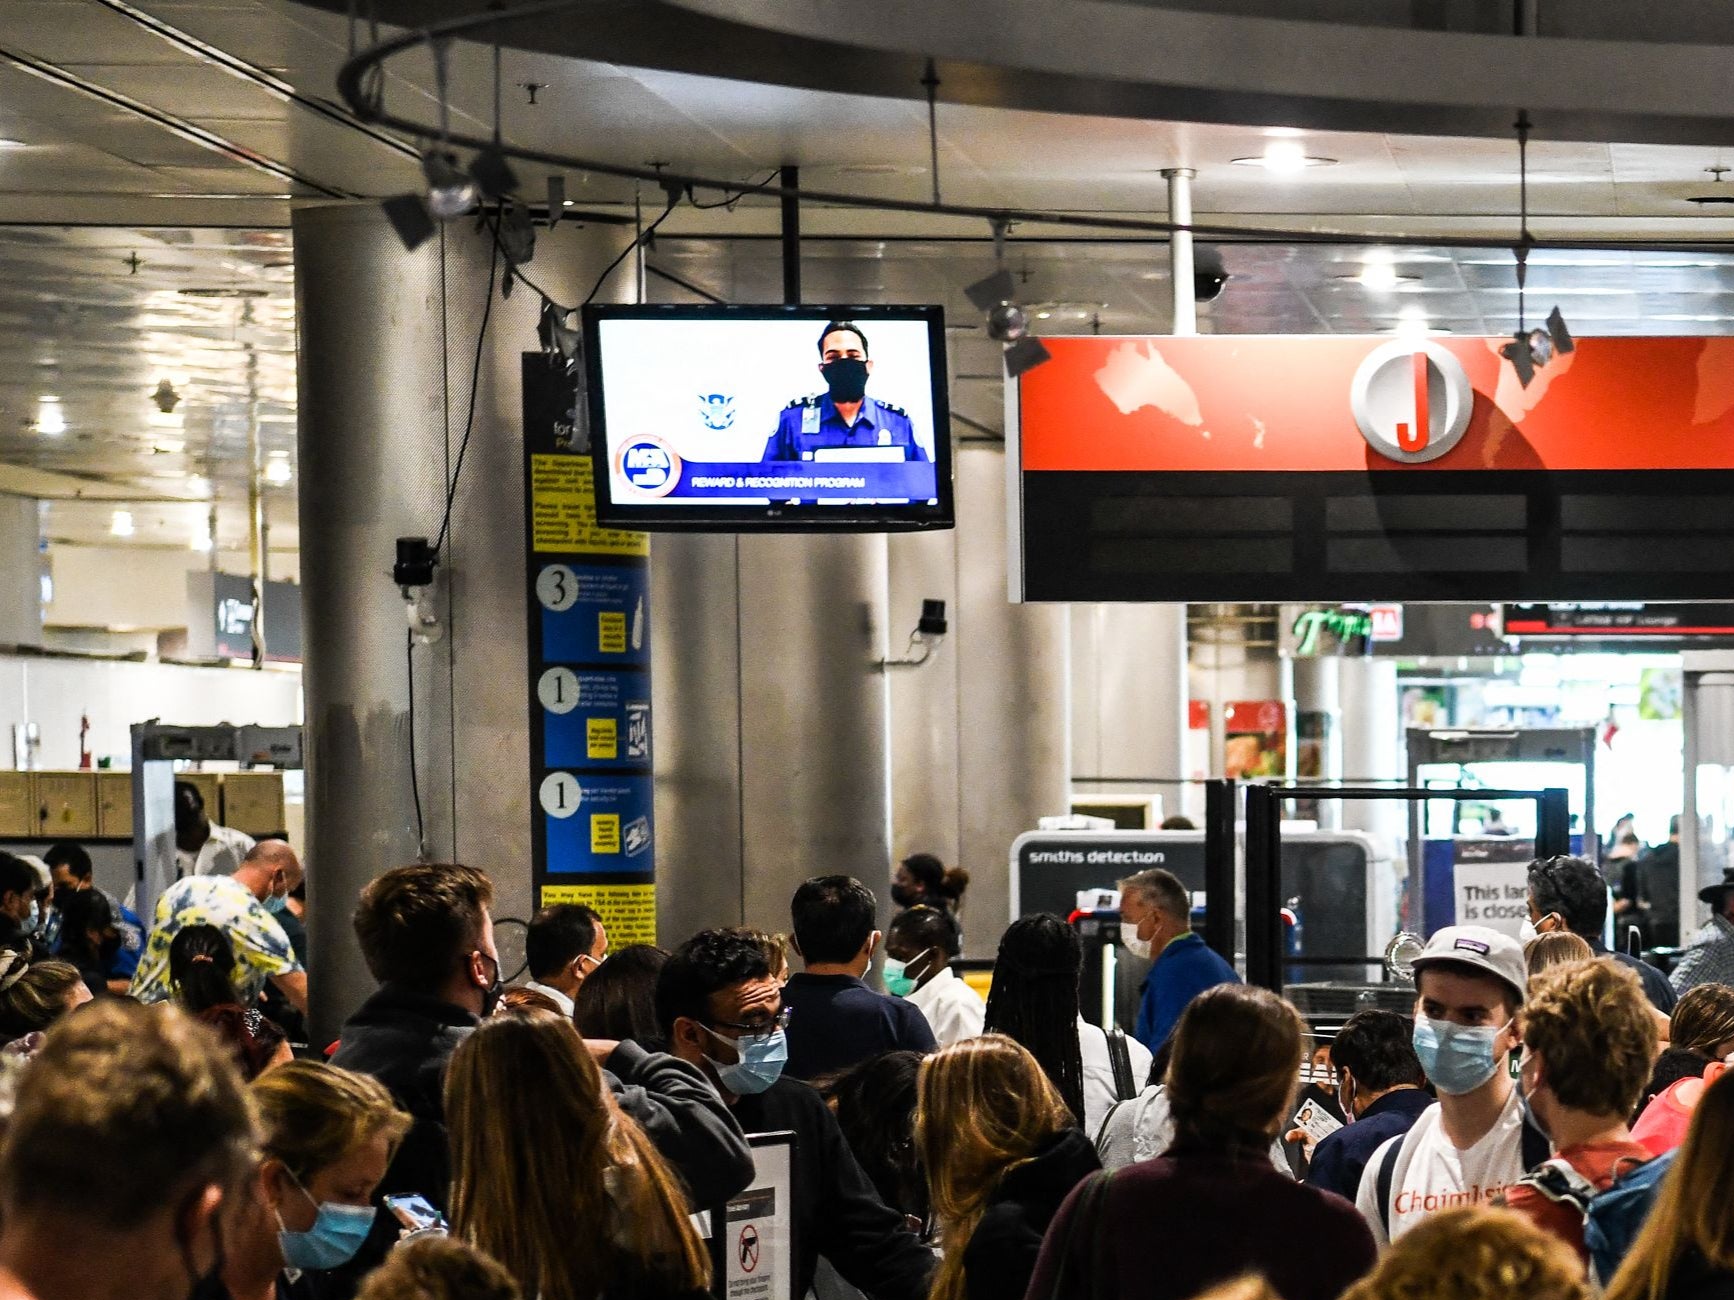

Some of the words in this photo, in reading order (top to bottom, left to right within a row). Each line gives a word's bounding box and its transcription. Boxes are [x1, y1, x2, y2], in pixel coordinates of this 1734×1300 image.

[1395, 352, 1428, 452] J
[691, 477, 734, 488] REWARD
[736, 477, 744, 488] &
[745, 477, 813, 488] RECOGNITION
[814, 477, 865, 488] PROGRAM
[551, 570, 566, 606] 3
[554, 675, 564, 704] 1
[555, 781, 567, 809] 1
[1029, 851, 1085, 863] smiths
[1087, 851, 1165, 863] detection
[1463, 885, 1500, 900] This
[1464, 904, 1478, 919] is
[1483, 904, 1527, 919] close
